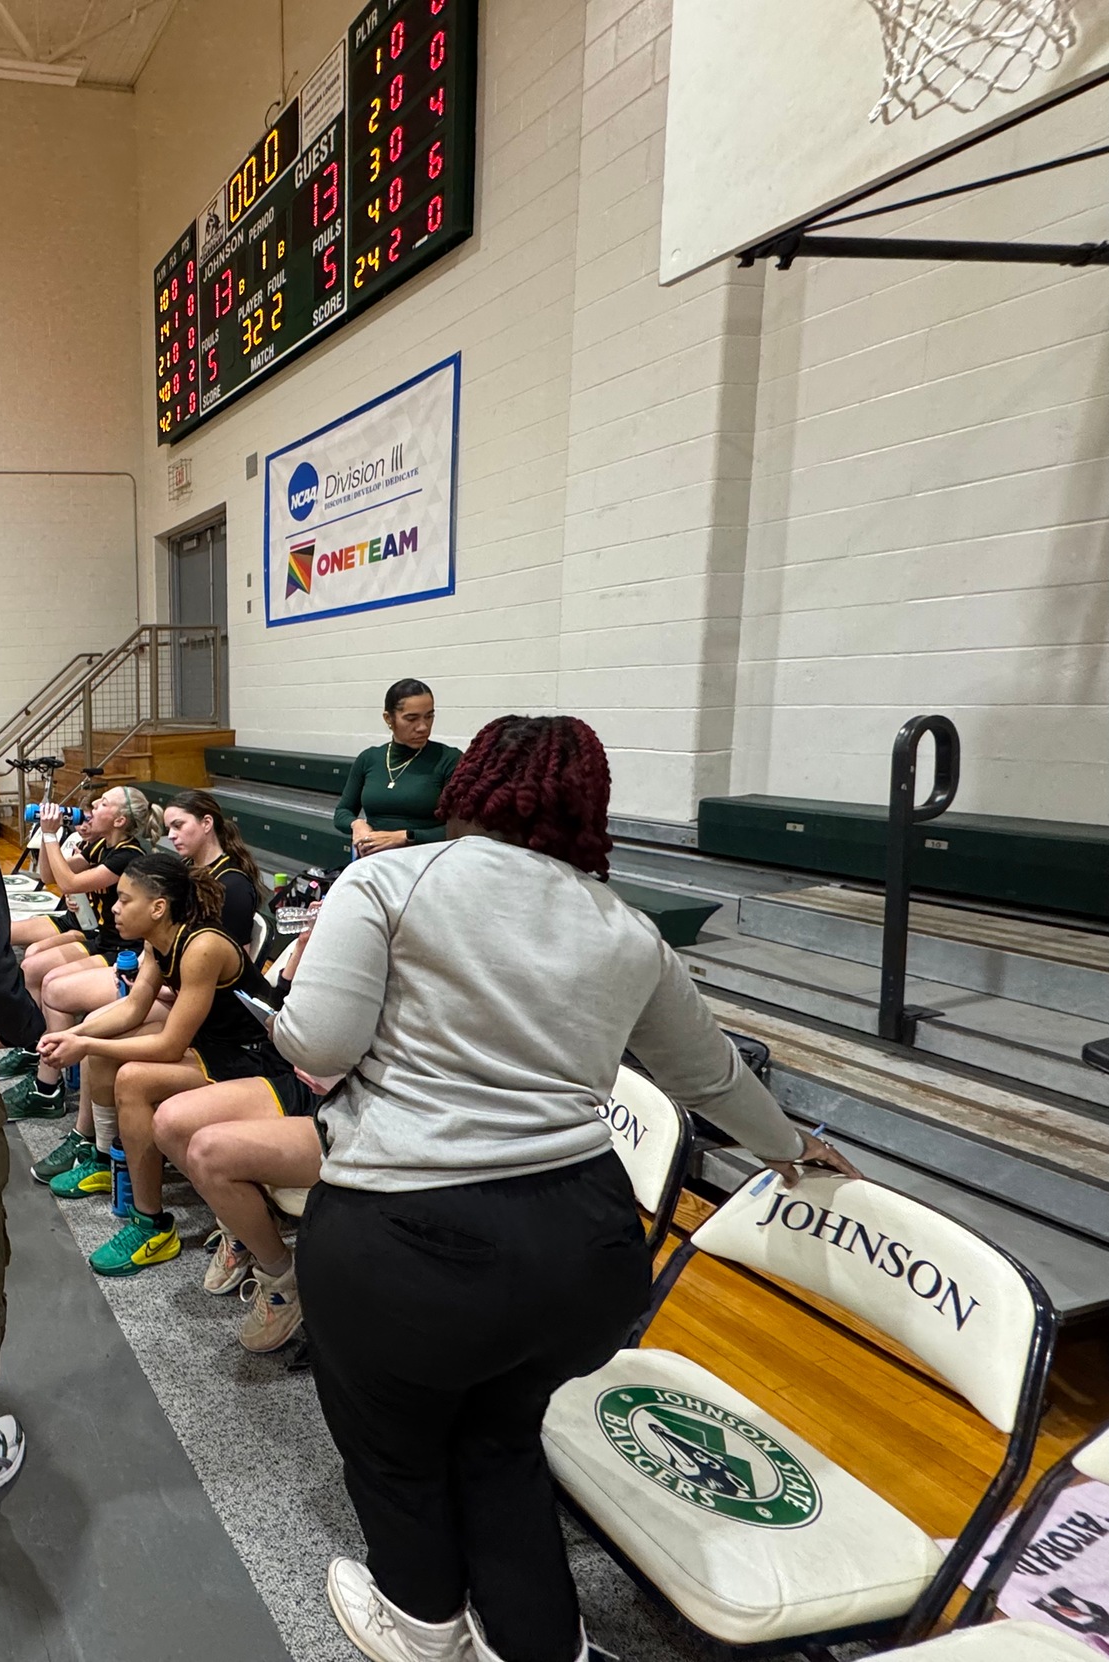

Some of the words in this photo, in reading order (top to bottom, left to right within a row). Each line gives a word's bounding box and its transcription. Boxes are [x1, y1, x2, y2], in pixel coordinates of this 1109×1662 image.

[355, 8, 378, 48] PLYR
[376, 48, 381, 75] 1
[391, 22, 404, 59] 0
[368, 98, 381, 133] 2
[391, 74, 403, 111] 0
[430, 32, 444, 70] 0
[294, 124, 337, 190] GUEST
[370, 147, 381, 183] 3
[390, 126, 403, 162] 0
[430, 88, 444, 116] 4
[313, 162, 338, 227] 13
[368, 198, 380, 224] 4
[389, 177, 402, 212] 0
[429, 142, 442, 180] 6
[203, 228, 244, 283] JOHNSON
[249, 206, 274, 245] PERIOD
[262, 240, 267, 271] 1
[312, 217, 342, 257] FOULS
[354, 246, 381, 289] 24
[389, 227, 401, 263] 2
[428, 195, 442, 233] 0
[160, 288, 169, 312] 10
[172, 278, 178, 301] 0
[187, 260, 194, 284] 0
[323, 245, 337, 289] 5
[160, 321, 170, 343] 14
[175, 312, 179, 328] 1
[187, 294, 194, 317] 0
[215, 268, 233, 319] 13
[238, 290, 263, 323] PLAYER
[267, 274, 287, 298] FOUL
[312, 290, 342, 327] SCORE
[201, 328, 219, 352] FOULS
[243, 308, 264, 355] 32
[271, 292, 283, 332] 2
[158, 352, 170, 377] 21
[172, 342, 179, 364] 0
[188, 327, 195, 350] 0
[208, 348, 217, 382] 5
[250, 343, 275, 373] MATCH
[159, 381, 171, 403] 40
[173, 373, 180, 395] 0
[188, 359, 195, 381] 2
[202, 384, 221, 408] SCORE
[159, 411, 171, 432] 42
[177, 405, 181, 422] 1
[189, 392, 196, 414] 0
[324, 458, 385, 500] Division
[391, 443, 403, 472] III
[324, 491, 351, 510] DISCOVER
[353, 481, 382, 500] DEVELOP
[385, 467, 419, 487] DEDICATE
[290, 485, 318, 511] NCAA
[316, 526, 418, 576] ONETEAM
[756, 1192, 981, 1332] JOHNSON
[603, 1410, 716, 1508] BADGERS
[654, 1390, 782, 1453] JOHNSON
[775, 1460, 811, 1514] STATE
